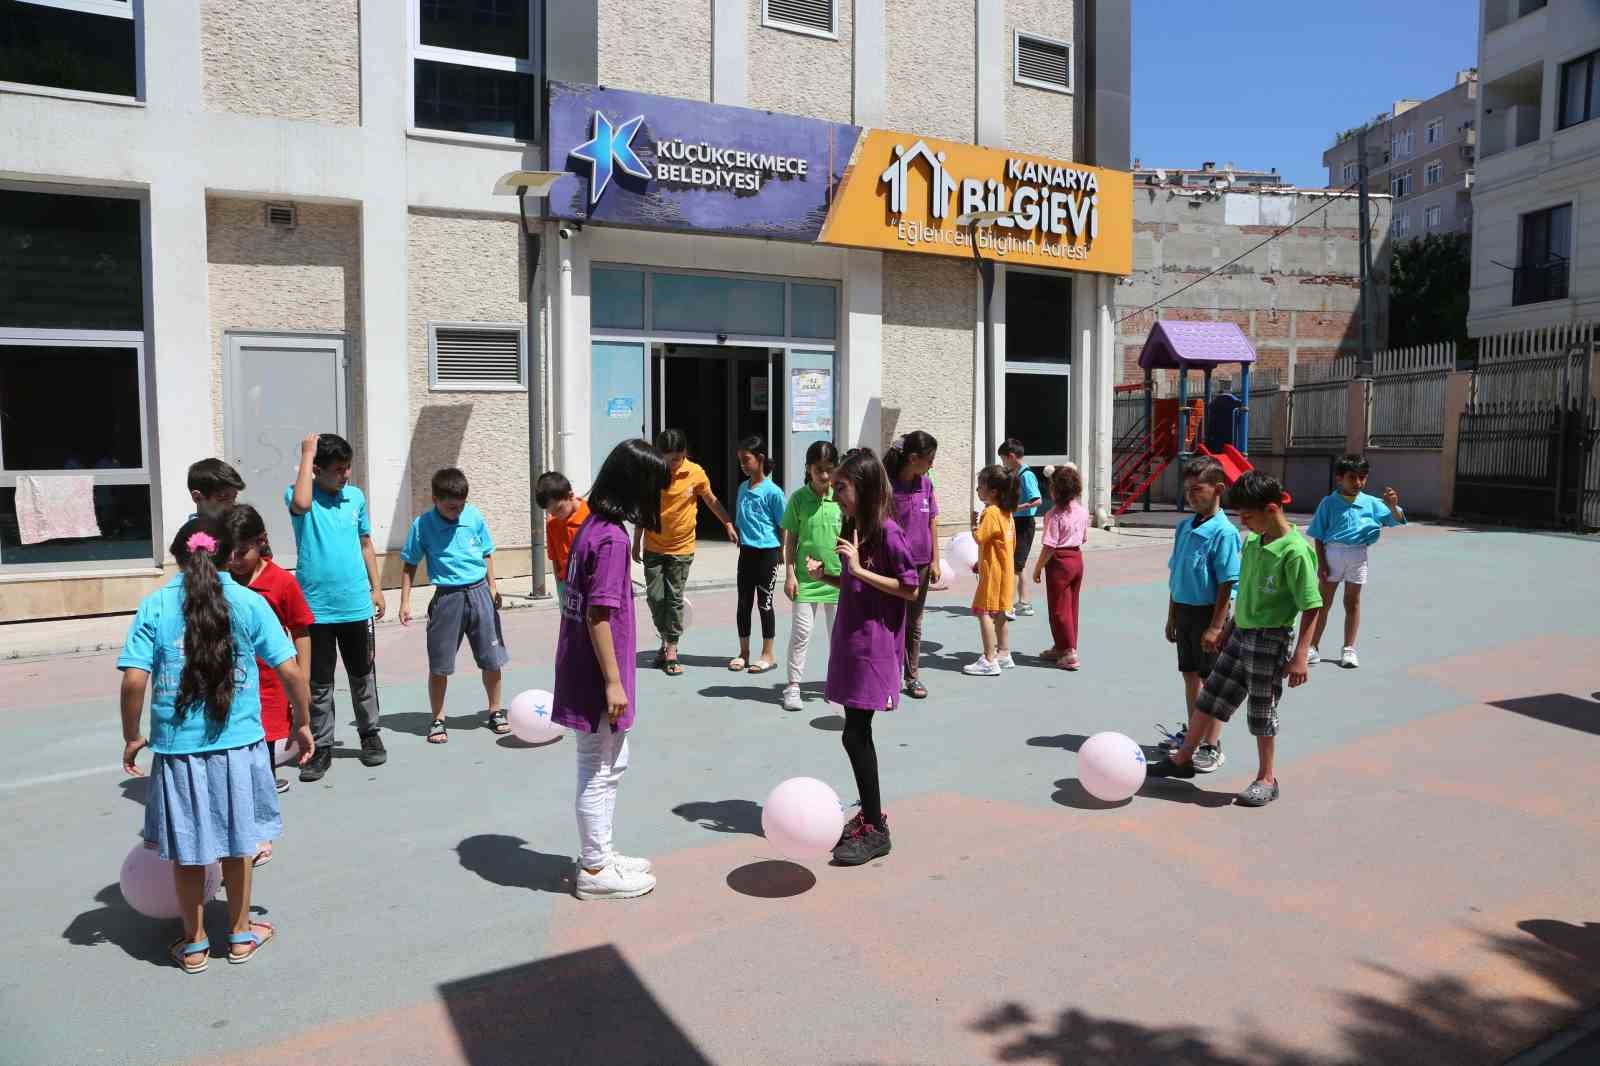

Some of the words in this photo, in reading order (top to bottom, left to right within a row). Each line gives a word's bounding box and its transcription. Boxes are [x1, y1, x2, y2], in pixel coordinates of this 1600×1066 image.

[657, 139, 808, 175] KÜÇÜKÇEKMECE
[657, 164, 761, 190] BELEDİYESİ
[1008, 158, 1099, 192] KANARYA
